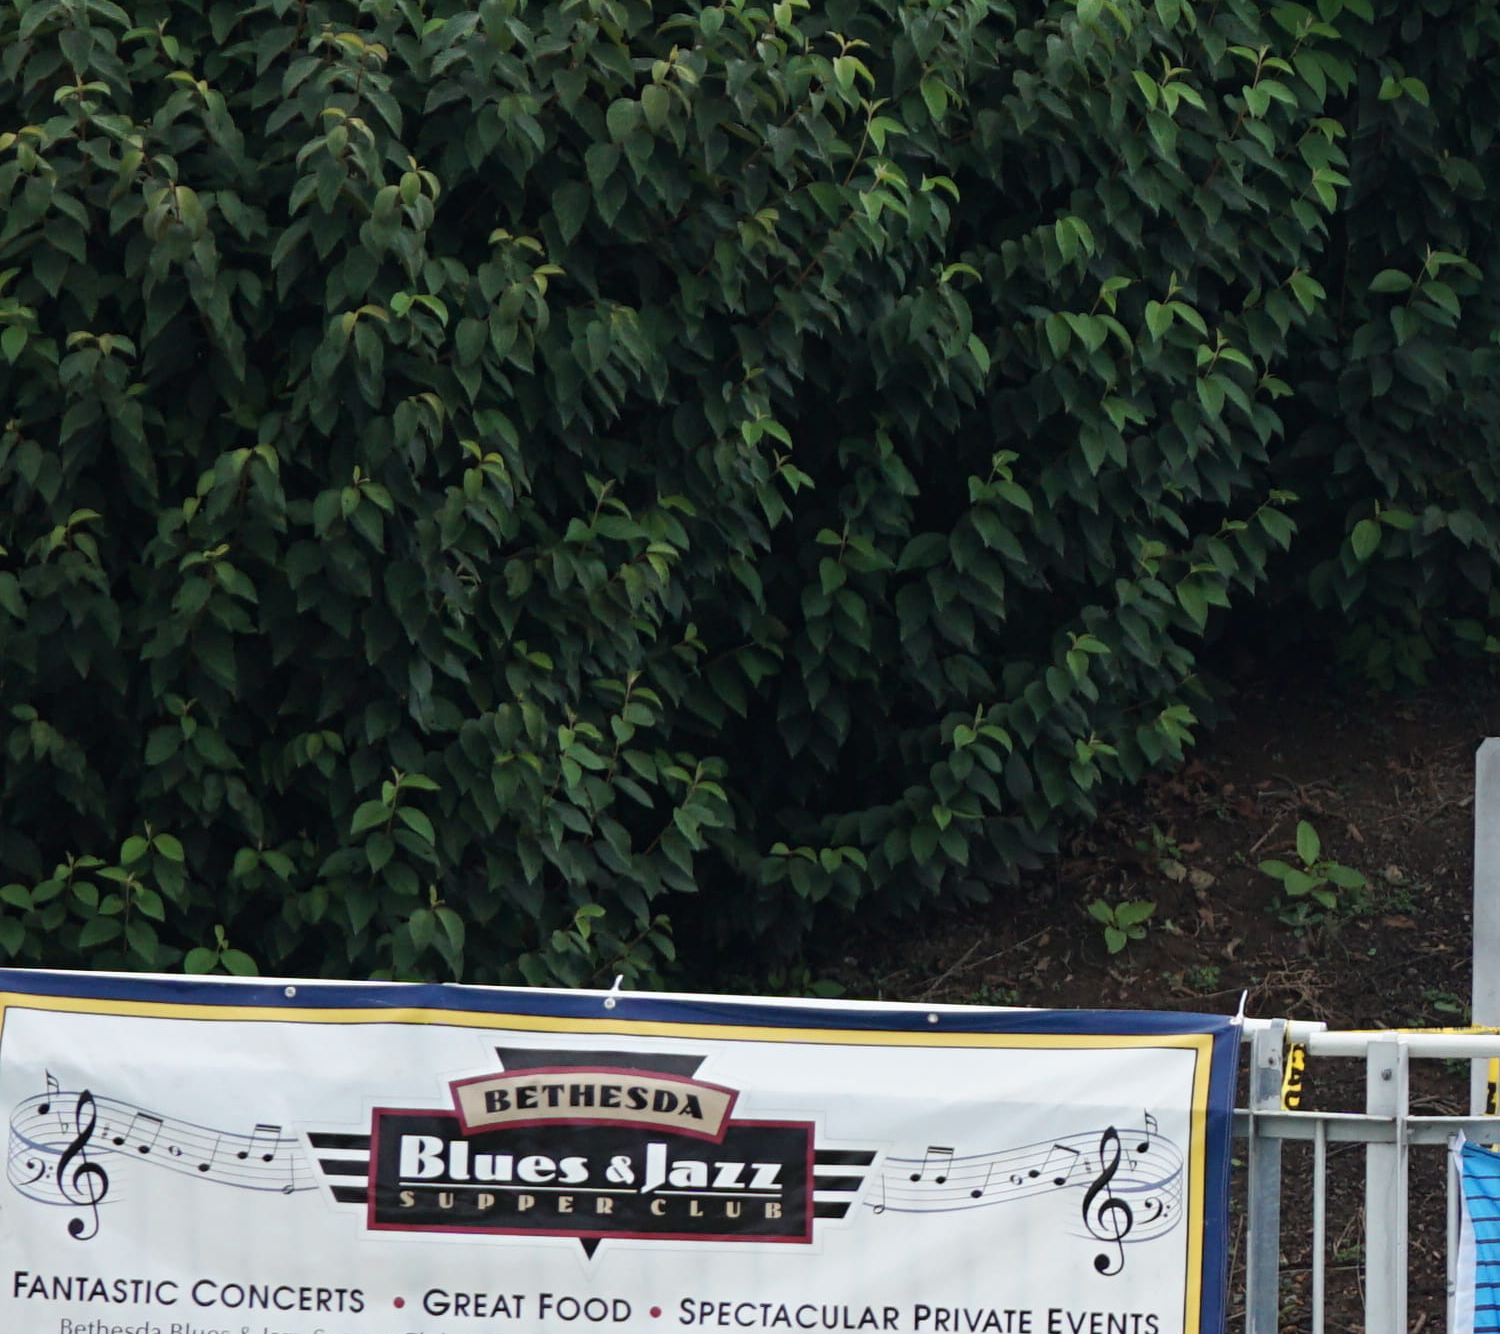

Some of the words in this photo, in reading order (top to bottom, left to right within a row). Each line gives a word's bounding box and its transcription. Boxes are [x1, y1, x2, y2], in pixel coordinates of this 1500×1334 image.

[484, 1083, 704, 1120] BETHESDA
[399, 1134, 588, 1184] Blues
[605, 1154, 635, 1185] &
[640, 1141, 783, 1194] Jazz
[400, 1190, 615, 1215] SUPPER
[650, 1197, 783, 1220] CLUB
[12, 1271, 179, 1306] FANTASTIC
[191, 1279, 365, 1314] CONCERTS
[423, 1288, 526, 1319] GREAT
[539, 1293, 632, 1323] FOOD
[679, 1298, 900, 1331] SPECTACULAR
[914, 1304, 1033, 1334] PRIVATE
